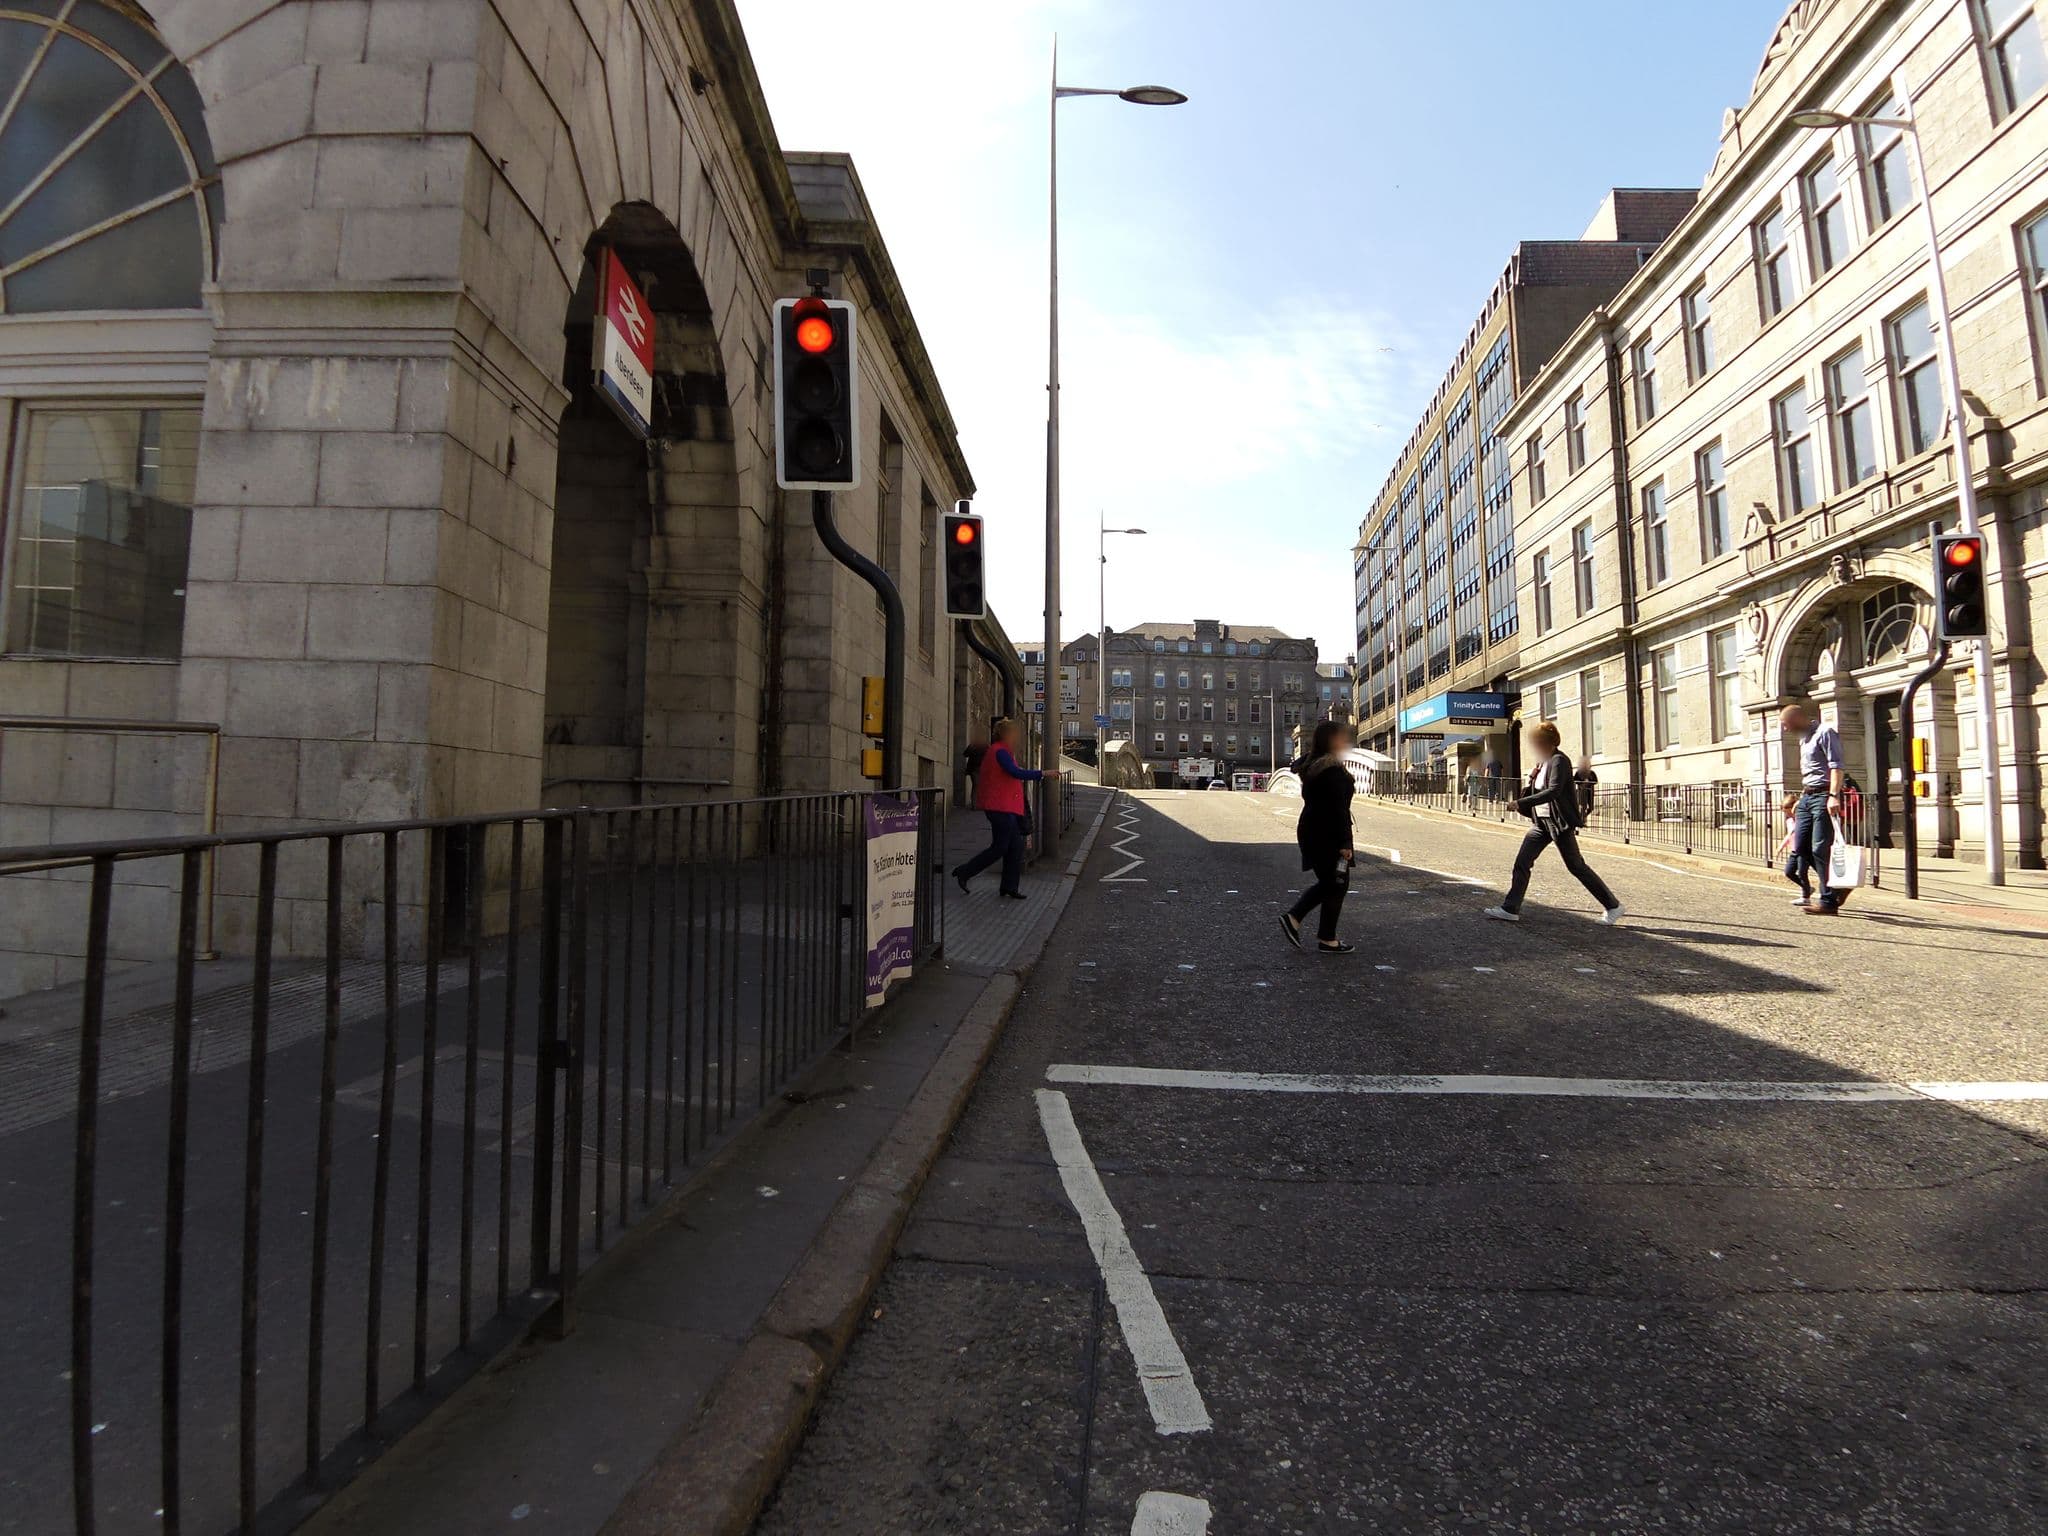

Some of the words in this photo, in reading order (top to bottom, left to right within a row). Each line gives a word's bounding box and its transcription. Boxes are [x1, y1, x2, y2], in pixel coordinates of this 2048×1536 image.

[614, 351, 644, 400] Aberdeen
[1453, 702, 1501, 710] TrinityCentre
[879, 854, 895, 871] Station
[895, 849, 917, 866] Hotel
